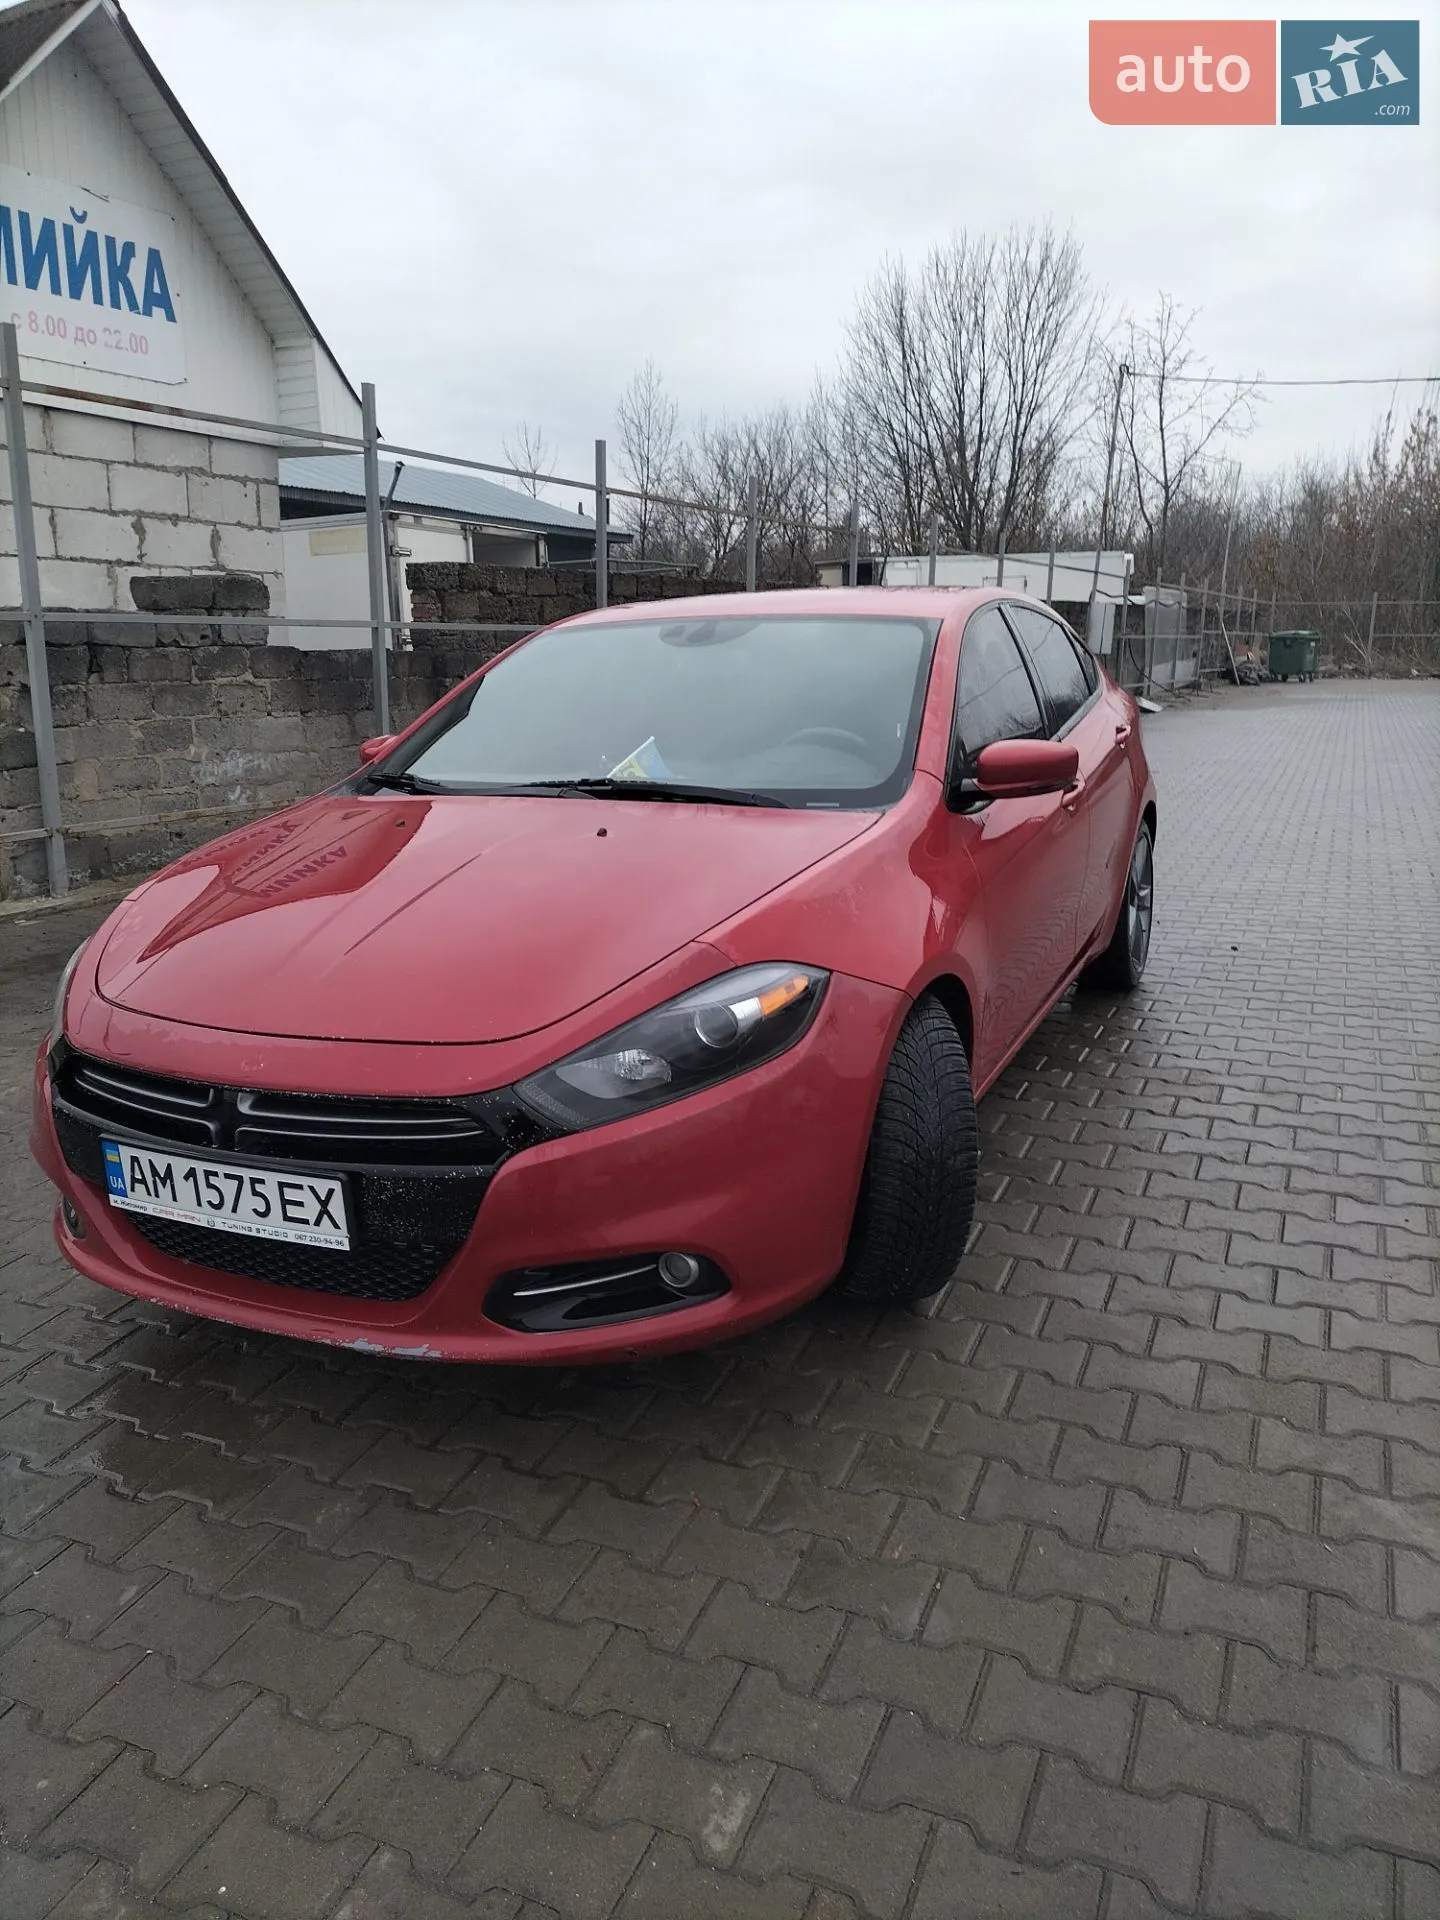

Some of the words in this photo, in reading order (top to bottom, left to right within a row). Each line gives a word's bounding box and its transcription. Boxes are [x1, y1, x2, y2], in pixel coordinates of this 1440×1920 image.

[28, 310, 67, 339] 8.00
[73, 326, 97, 348] до
[102, 327, 149, 355] 22.00
[109, 1175, 125, 1191] UA
[182, 1166, 272, 1218] 1575
[221, 1221, 253, 1233] TUNING
[255, 1227, 289, 1239] STUDIO
